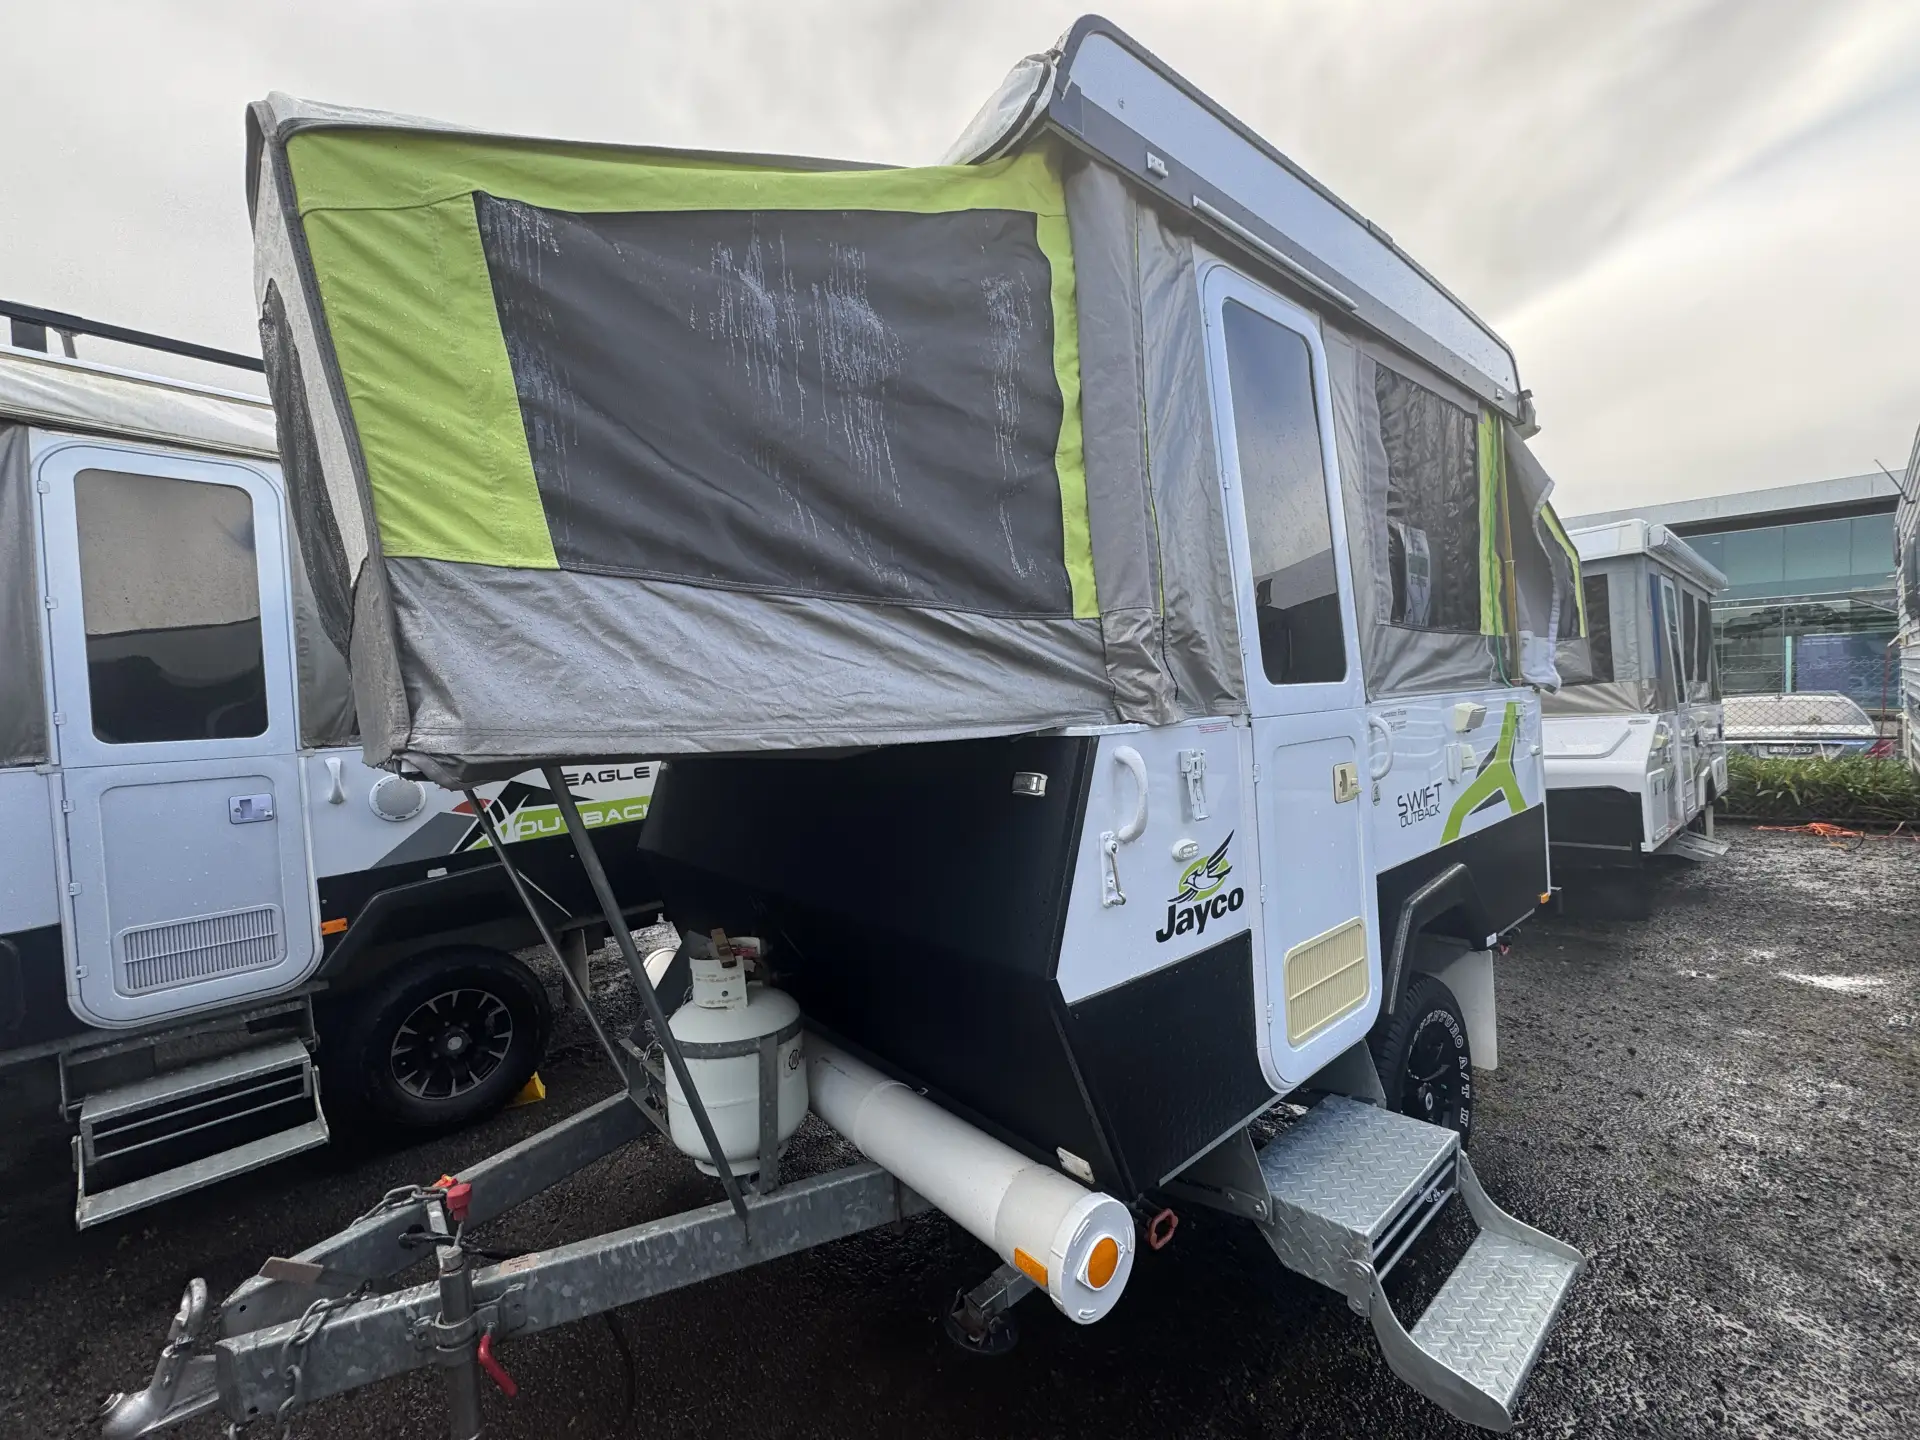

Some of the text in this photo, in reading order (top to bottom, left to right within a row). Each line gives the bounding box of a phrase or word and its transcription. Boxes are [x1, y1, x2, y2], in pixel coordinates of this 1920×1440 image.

[563, 766, 650, 786] EAGLE
[1397, 782, 1442, 817] SWIFT
[1400, 803, 1441, 828] OUTBACK
[516, 804, 650, 837] OUBAC
[1155, 887, 1244, 943] Jayco
